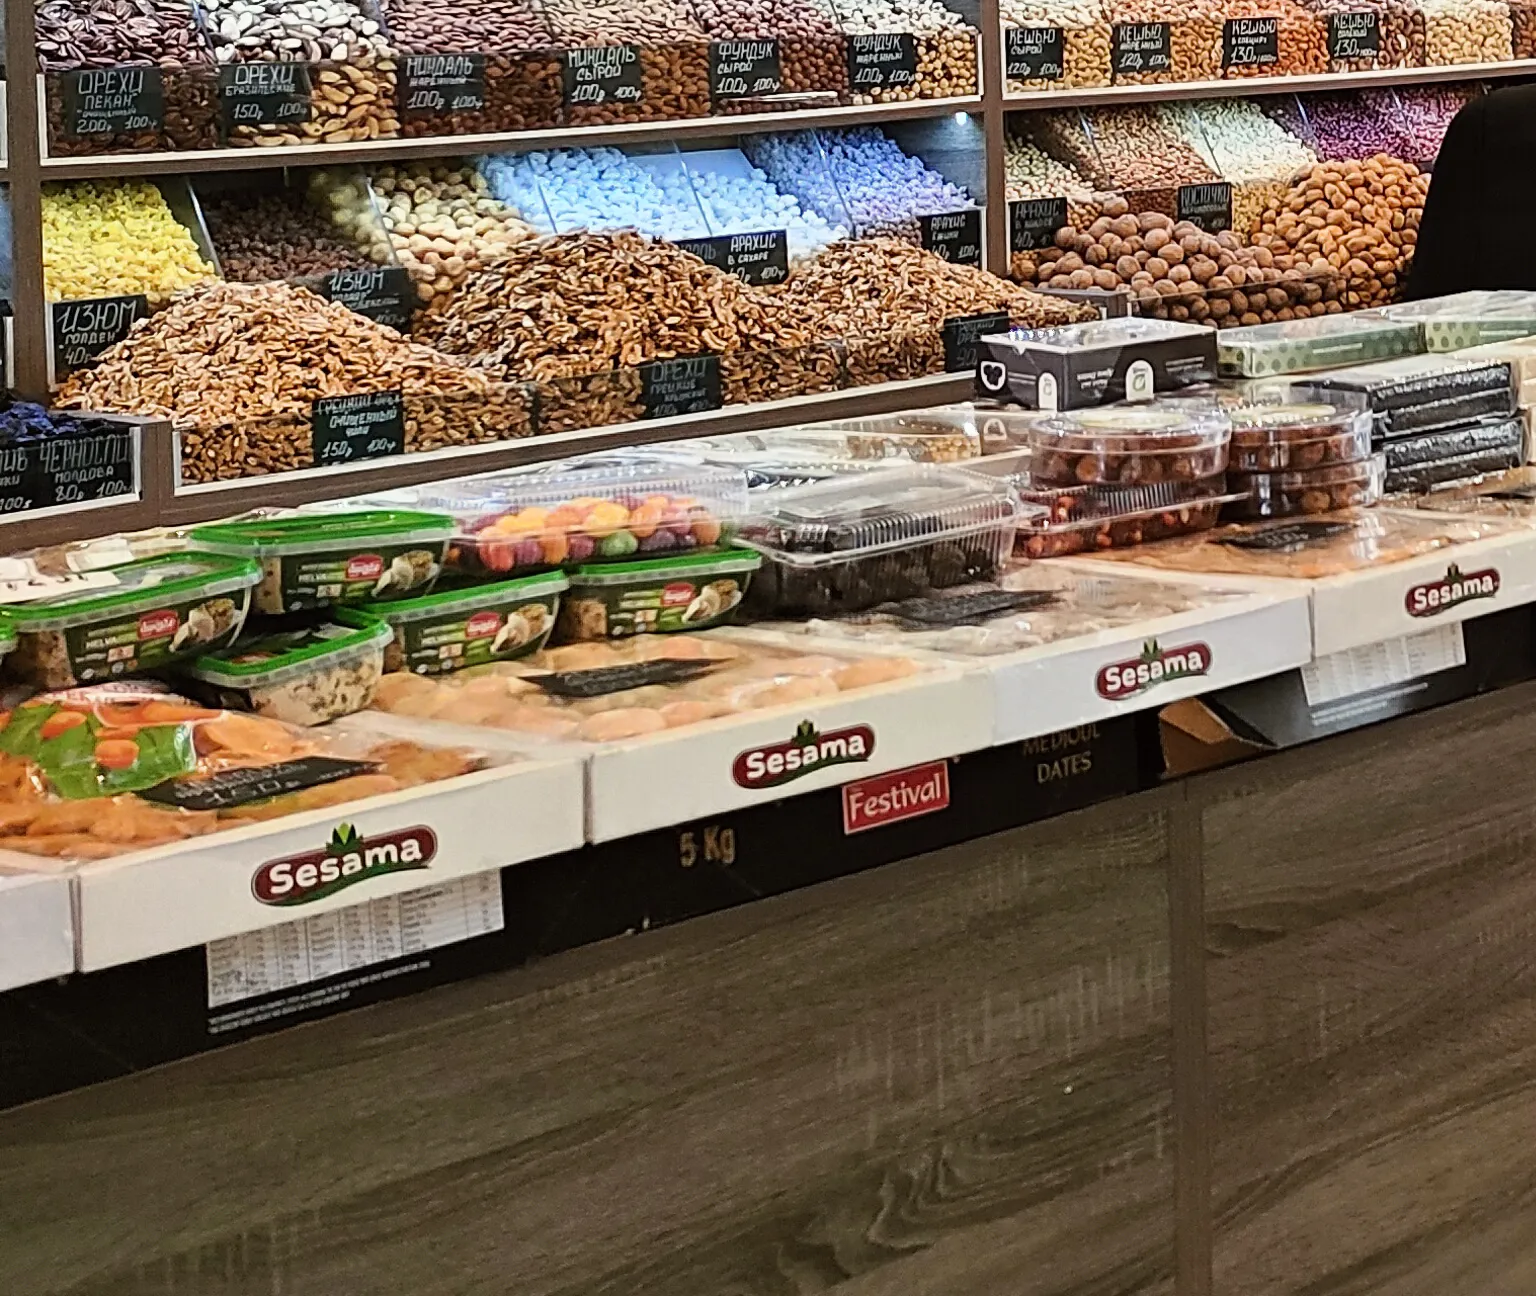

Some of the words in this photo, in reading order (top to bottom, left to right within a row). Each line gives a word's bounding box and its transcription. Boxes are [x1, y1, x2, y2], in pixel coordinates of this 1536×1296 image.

[1119, 24, 1163, 41] КЕШЬЮ
[1232, 19, 1277, 36] КЕШЬЮ
[1334, 13, 1375, 29] КЕШЬЮ
[853, 34, 901, 55] ФУНДУК
[1009, 29, 1056, 46] КЕШЬЮ
[568, 46, 637, 70] МИНДАЛЬ
[718, 41, 774, 65] ФУНДУК
[235, 64, 296, 85] ОРЕХИ
[406, 56, 474, 78] МИНДАЛЬ
[77, 70, 144, 95] ОРЕХИ
[1180, 184, 1231, 206] КОСТОЧКИ
[730, 232, 777, 252] АРАХИС
[329, 270, 385, 292] ИЗЮМ
[56, 300, 137, 334] ИЗЮМ
[651, 357, 707, 383] ОРЕХИ
[40, 434, 130, 474] ЧЕРНОСЛИ
[55, 465, 115, 484] МОЛДОВА
[1412, 574, 1497, 612] Sesama
[1105, 648, 1205, 693] Sesama
[744, 732, 867, 781] Sesama
[1036, 751, 1094, 785] DATES
[848, 772, 943, 822] Festival
[678, 831, 698, 869] 5
[703, 825, 738, 869] Kg
[267, 834, 424, 897] Sesama
